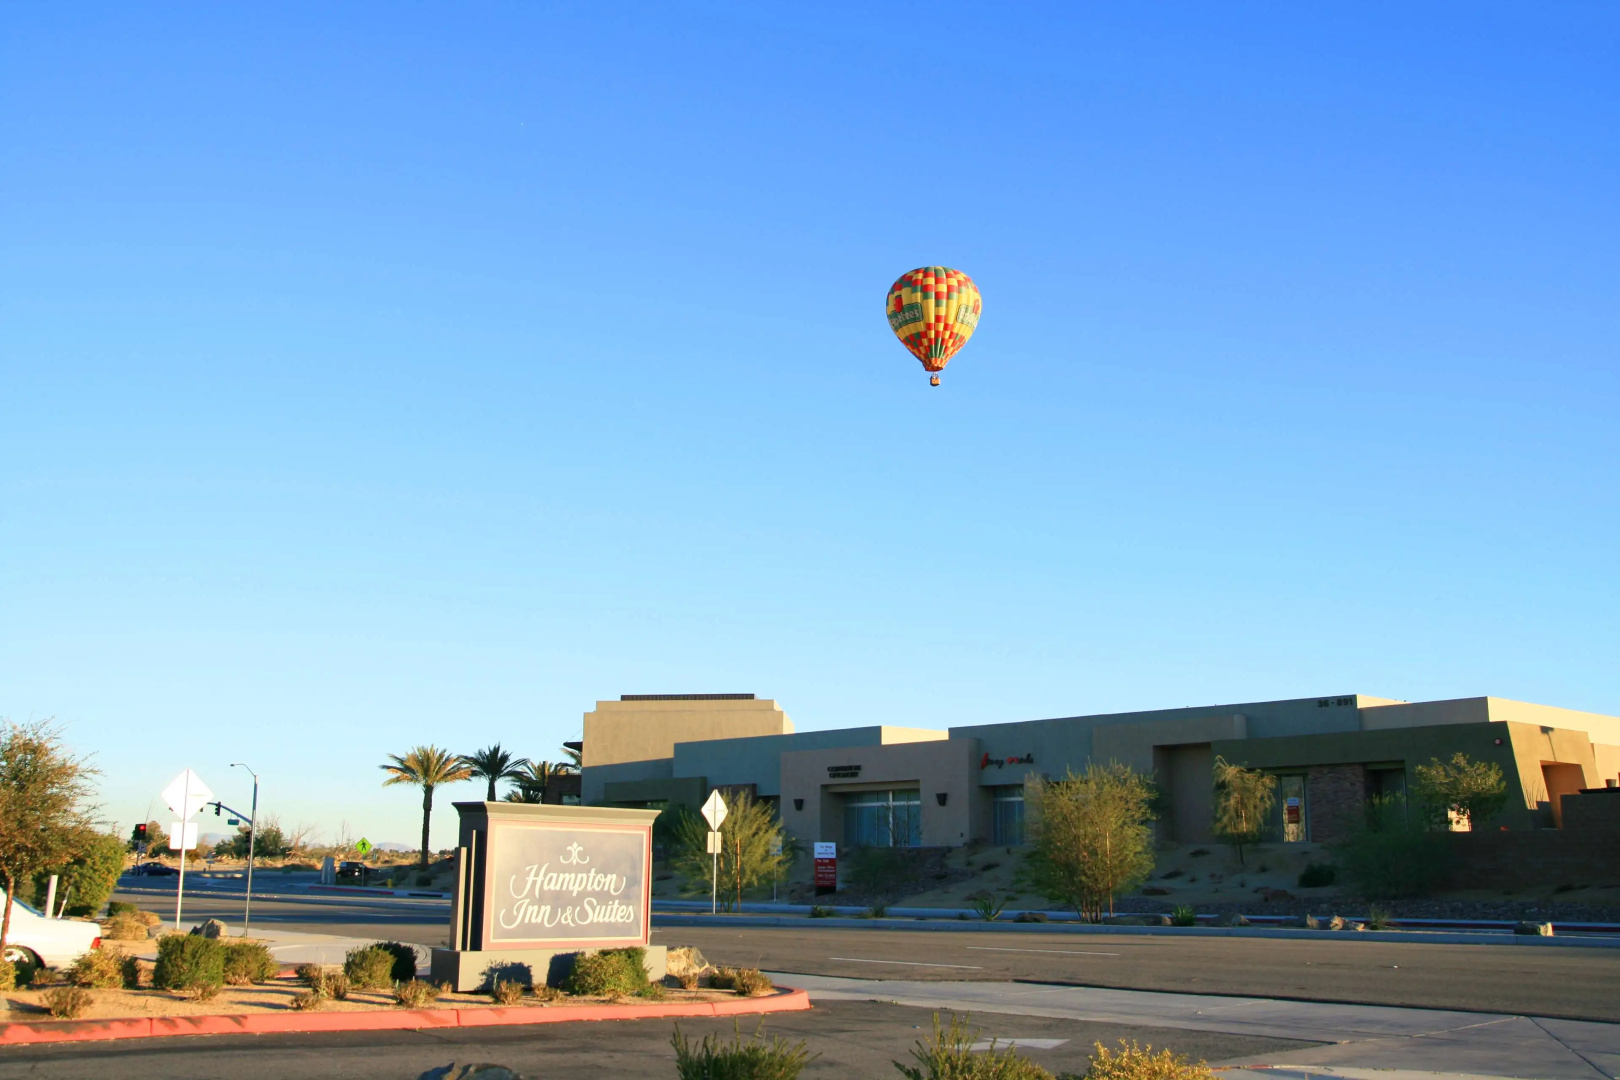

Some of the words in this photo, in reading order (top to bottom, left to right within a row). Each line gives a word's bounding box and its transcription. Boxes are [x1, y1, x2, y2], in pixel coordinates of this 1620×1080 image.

[510, 863, 626, 898] Hampton
[500, 899, 561, 929] Inn
[561, 906, 576, 926] &
[575, 897, 634, 925] Suites
